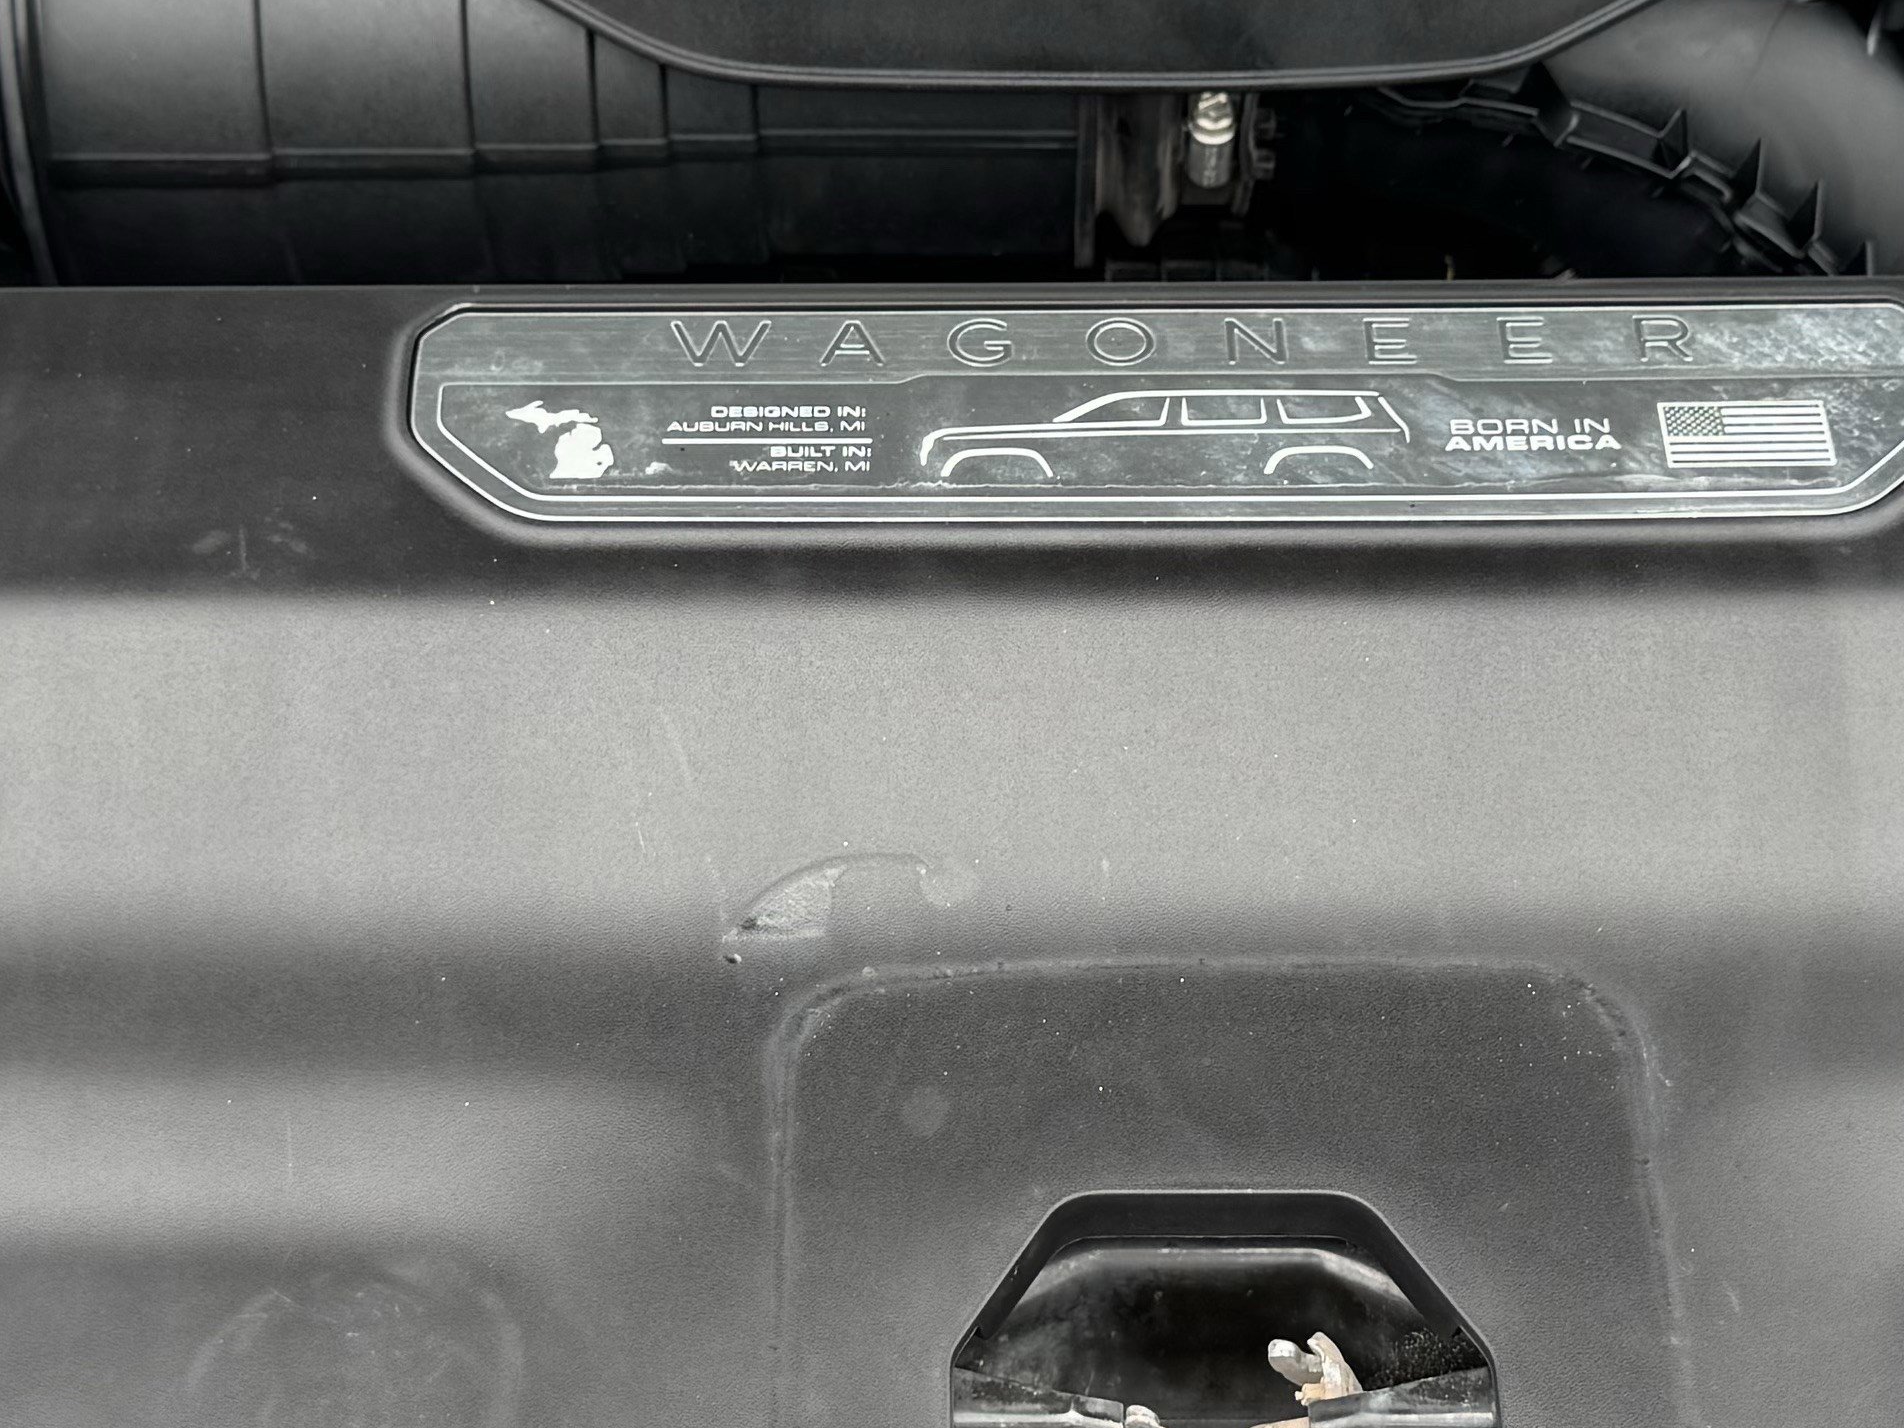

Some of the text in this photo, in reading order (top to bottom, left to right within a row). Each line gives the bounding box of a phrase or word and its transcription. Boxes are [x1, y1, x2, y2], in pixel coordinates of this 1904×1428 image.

[669, 314, 1694, 368] WAGONEER
[710, 405, 866, 418] DESIGNED IN:
[666, 421, 865, 433] AUBURN HILLS, MI
[1449, 417, 1611, 435] BORN IN
[1444, 434, 1622, 452] AMERICA
[770, 445, 872, 458] BUILT IN:
[731, 459, 870, 472] WARREN, MI
